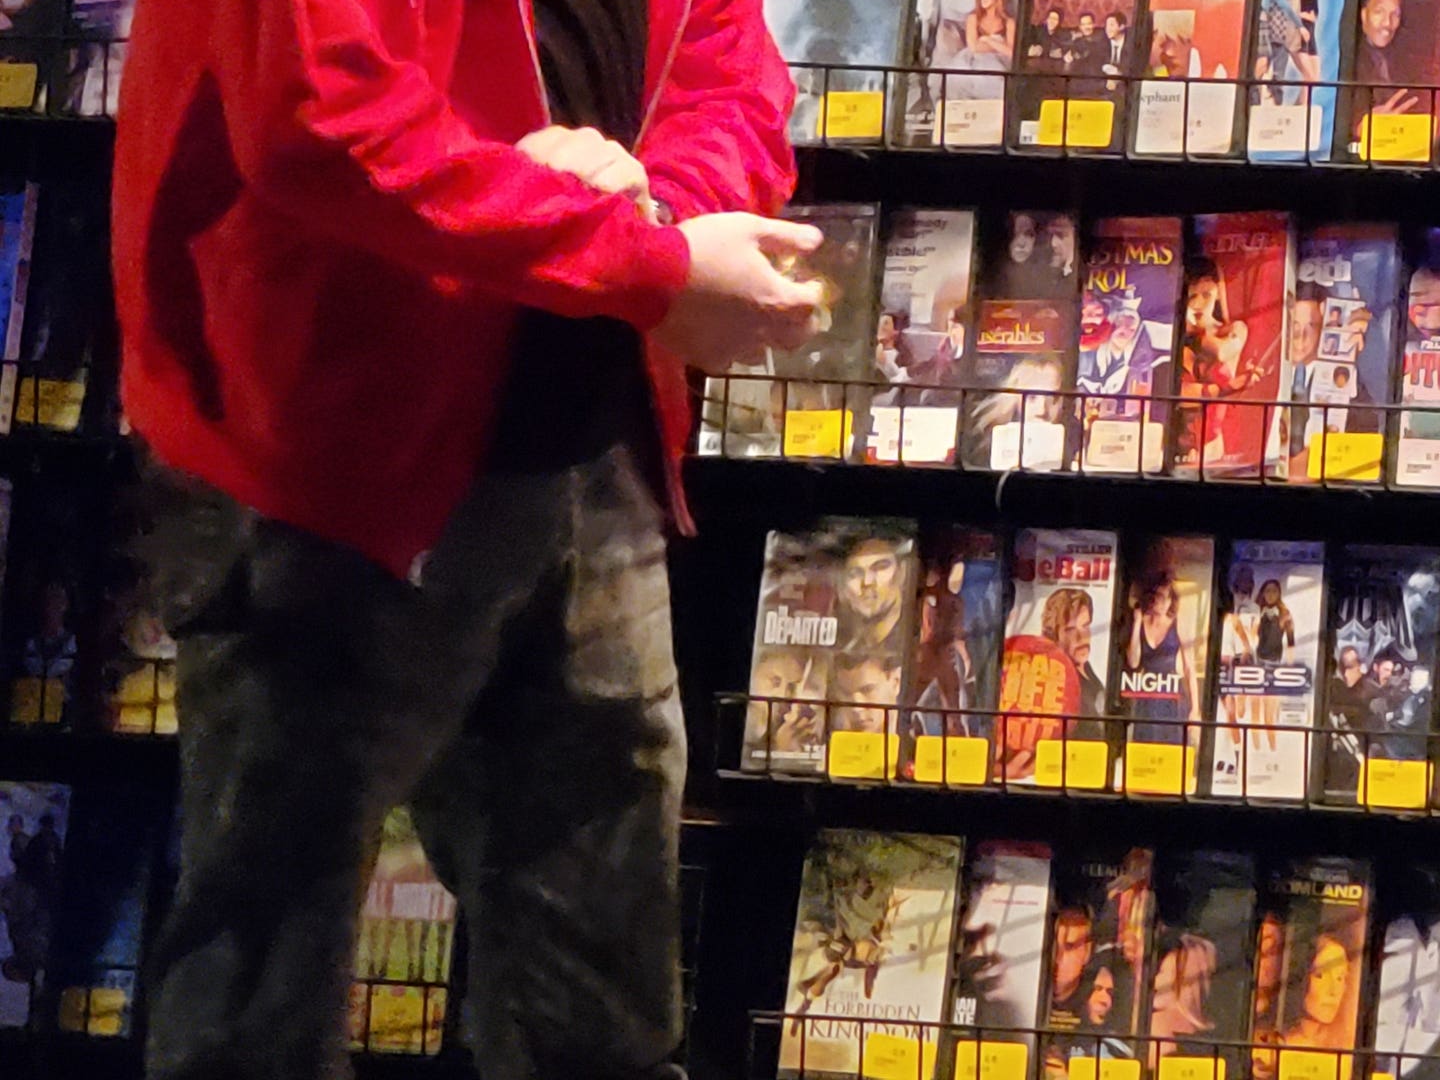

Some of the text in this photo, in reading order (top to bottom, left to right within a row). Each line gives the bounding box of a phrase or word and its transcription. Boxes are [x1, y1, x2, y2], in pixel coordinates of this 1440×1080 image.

[1018, 556, 1111, 581] eBall
[763, 611, 838, 646] DEPARTED
[1120, 671, 1183, 694] NIGHT
[824, 1000, 922, 1020] FORBIDDEN
